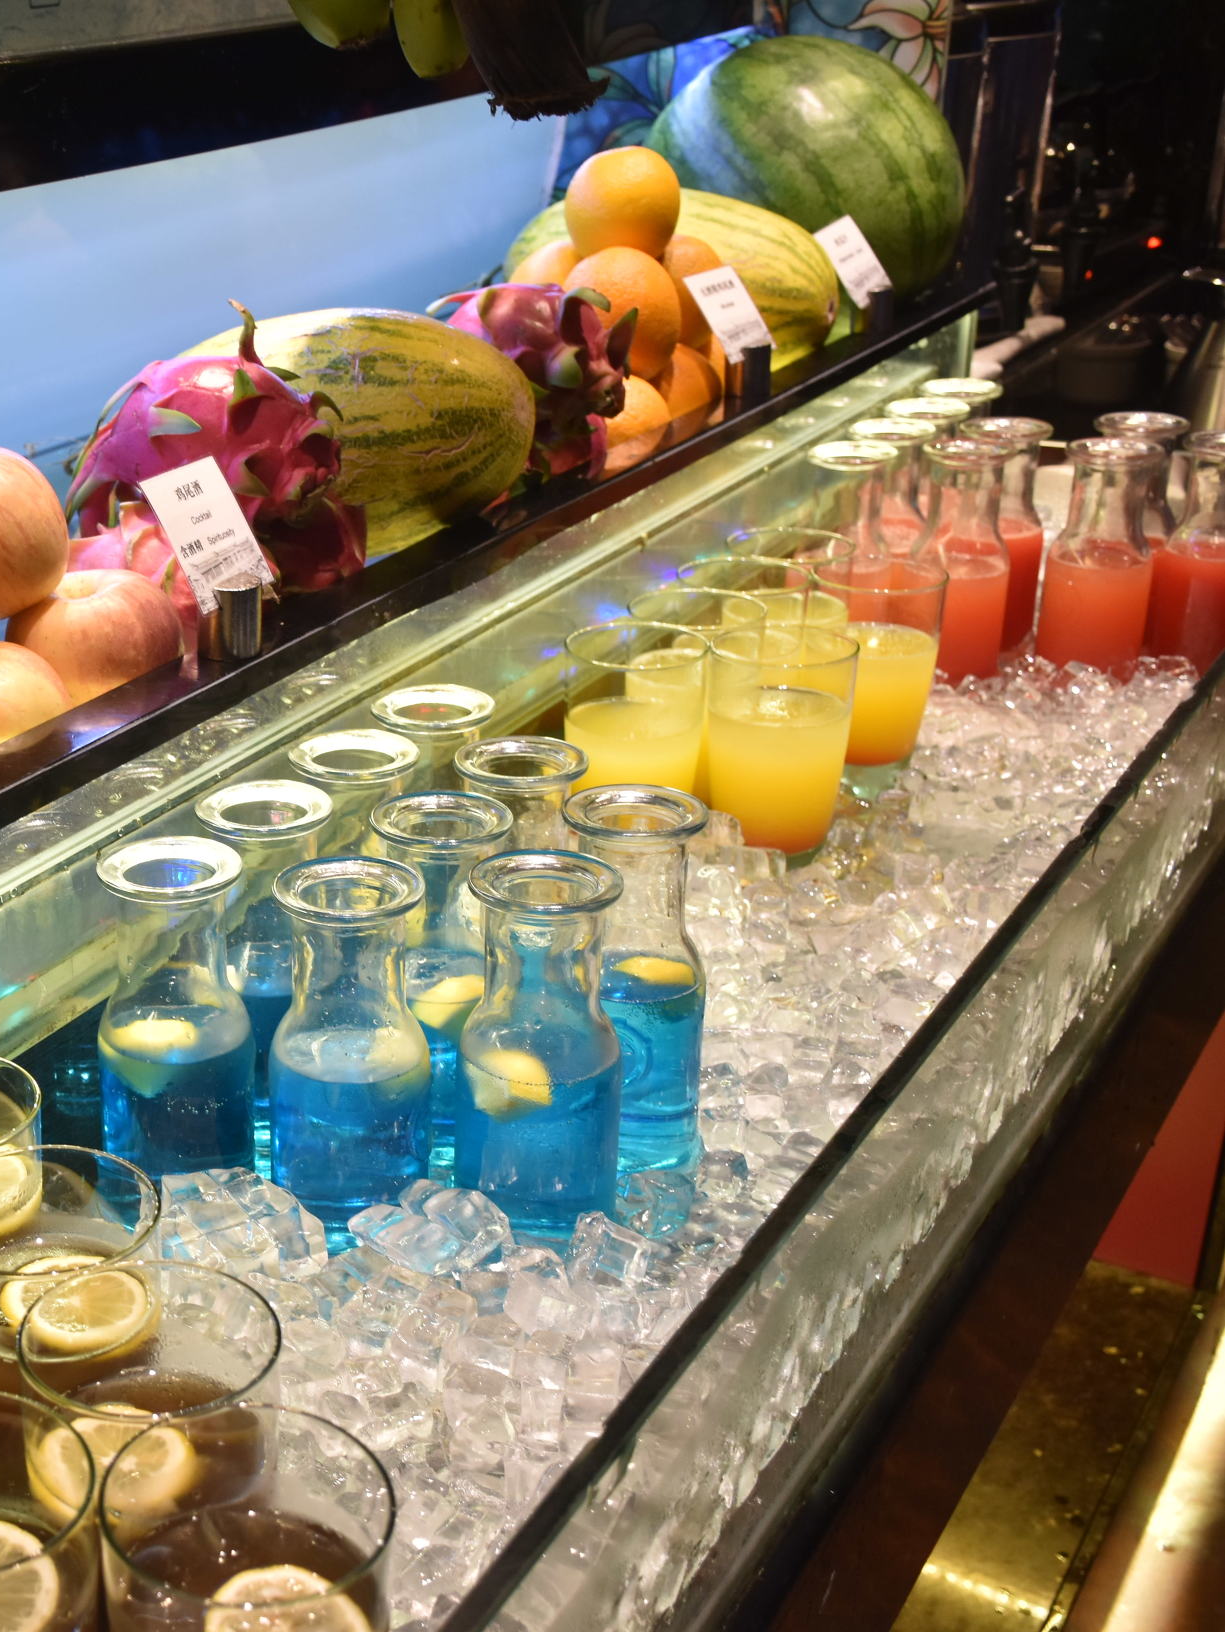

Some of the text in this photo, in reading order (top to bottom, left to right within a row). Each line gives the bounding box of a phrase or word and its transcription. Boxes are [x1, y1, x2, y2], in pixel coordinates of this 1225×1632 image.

[175, 479, 204, 502] 鸡尾酒
[190, 510, 213, 525] Cocktail
[180, 539, 204, 559] 含酒精
